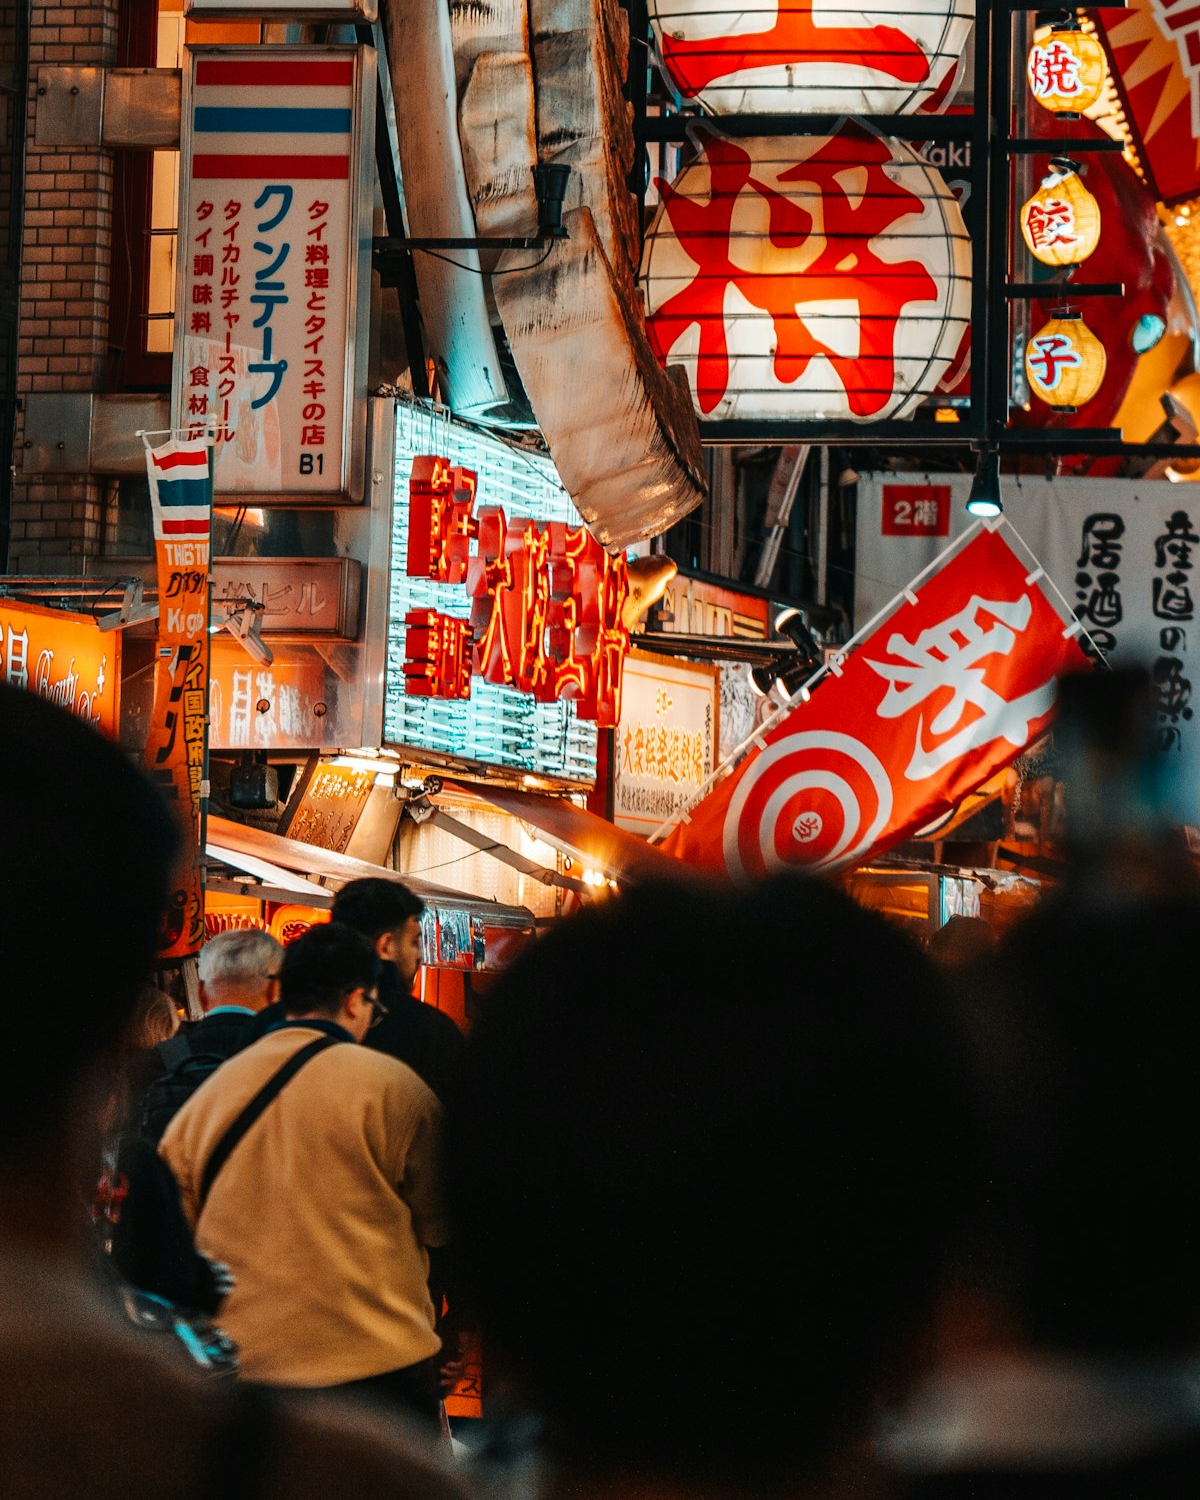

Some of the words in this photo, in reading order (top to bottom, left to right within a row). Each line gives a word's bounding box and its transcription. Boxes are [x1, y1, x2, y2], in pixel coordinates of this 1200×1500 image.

[926, 140, 972, 168] aki
[191, 201, 215, 334] タイ調味料
[215, 200, 242, 442] タイカルチャースクール
[247, 184, 294, 410] クンテープ
[299, 200, 330, 446] タイ料理とタイスキの店
[299, 453, 324, 476] B1
[894, 500, 938, 527] 2階
